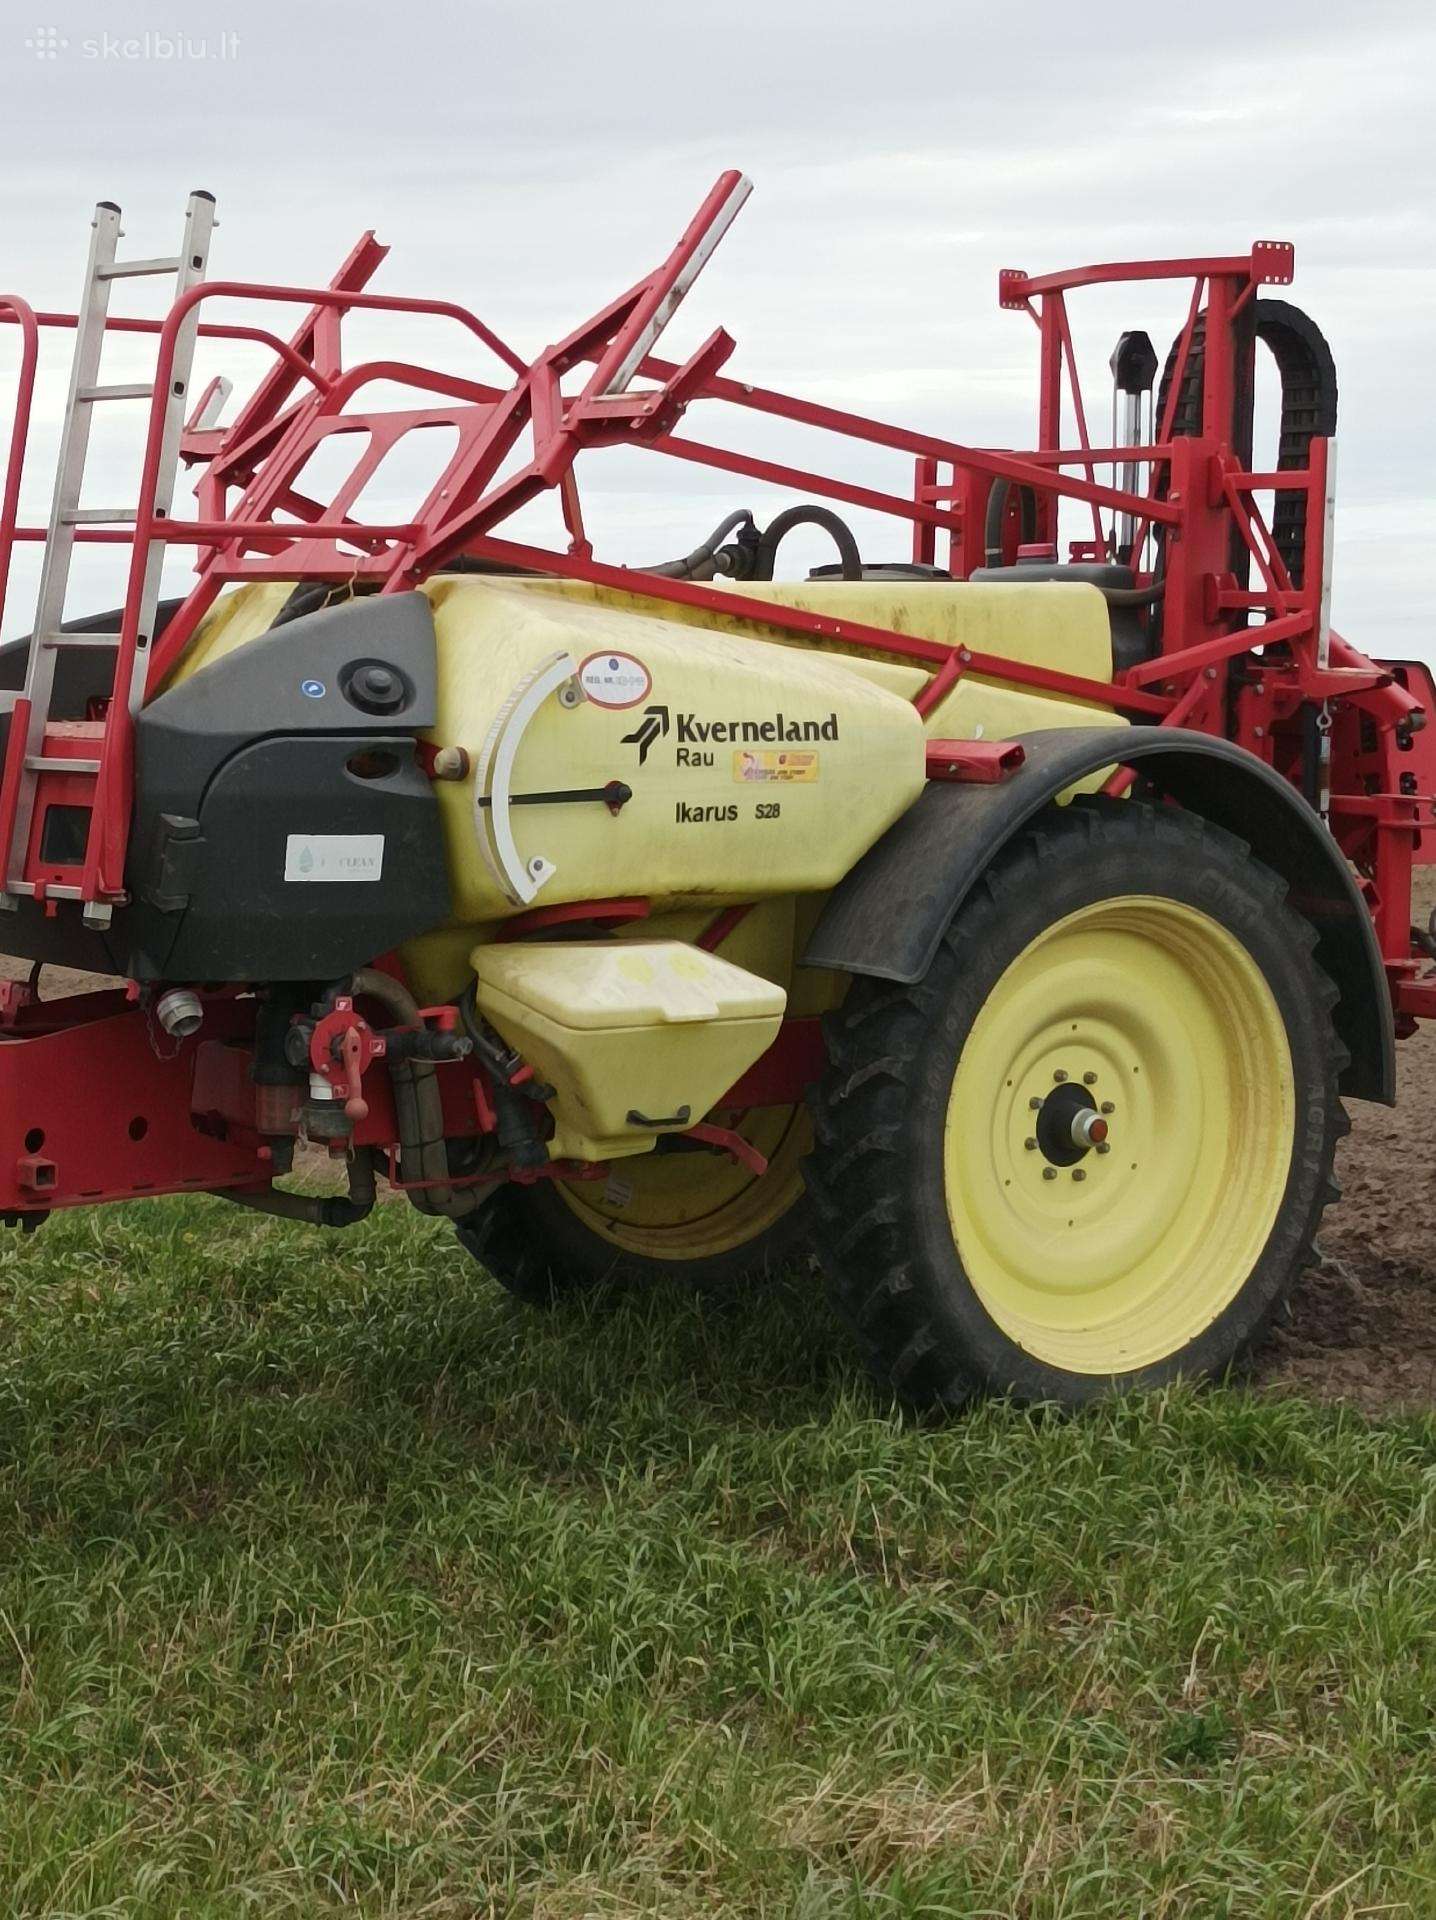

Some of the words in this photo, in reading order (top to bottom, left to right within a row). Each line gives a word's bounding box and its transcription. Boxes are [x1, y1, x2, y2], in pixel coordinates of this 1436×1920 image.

[676, 713, 839, 742] Kverneland
[676, 747, 714, 767] Rau
[676, 802, 738, 823] Ikarus
[755, 803, 781, 820] S28
